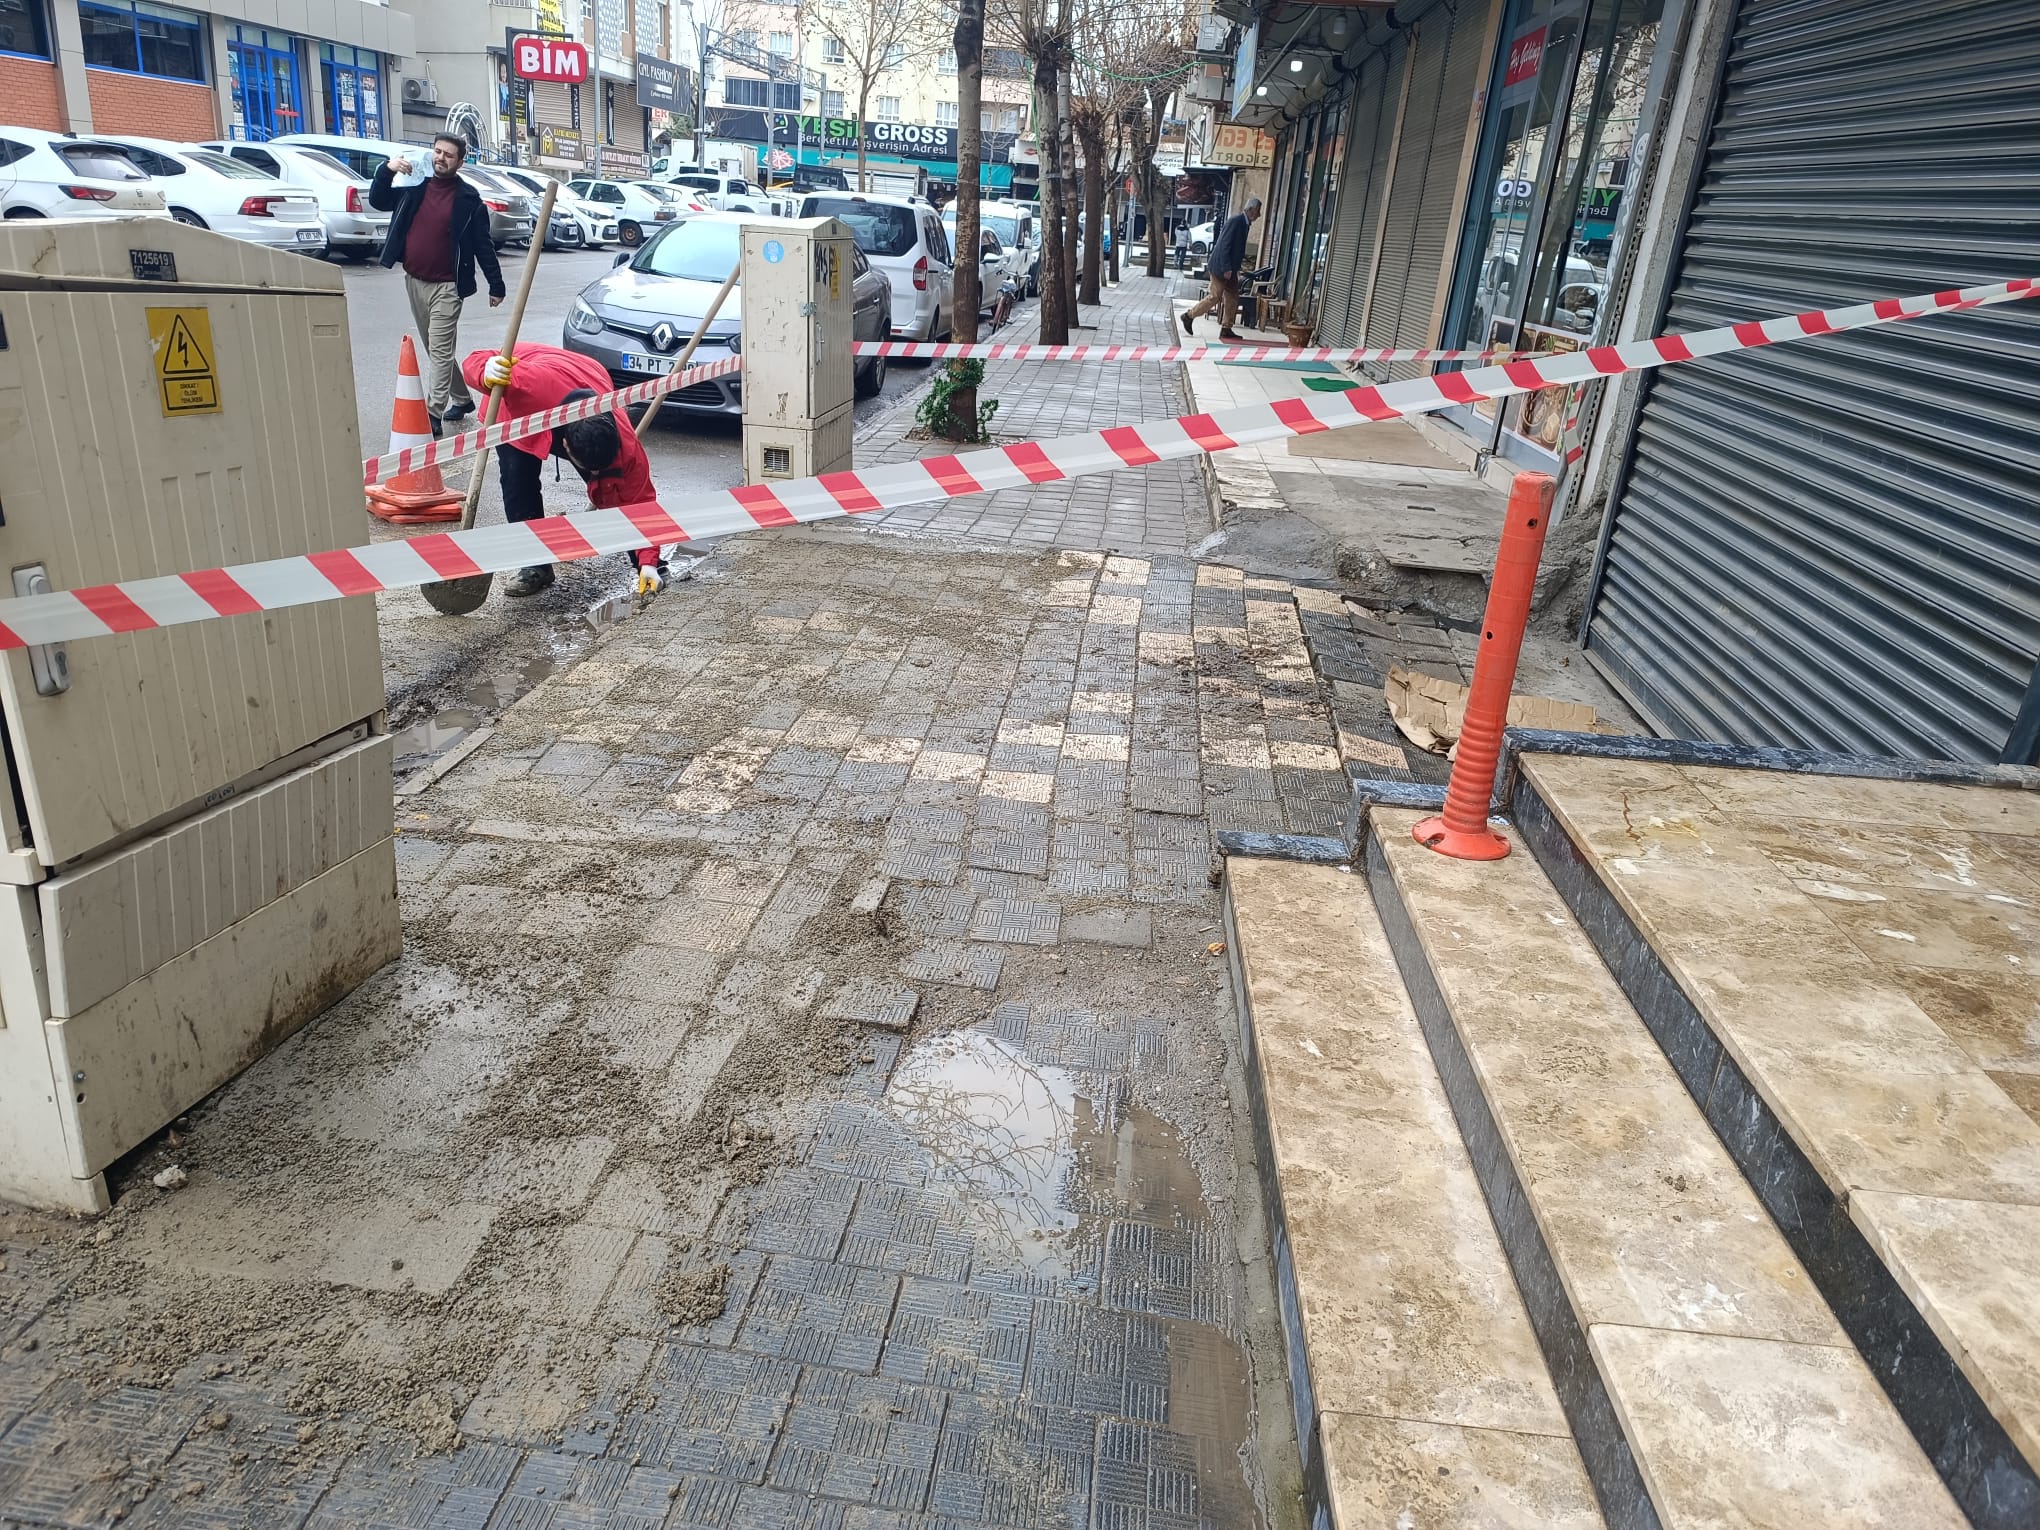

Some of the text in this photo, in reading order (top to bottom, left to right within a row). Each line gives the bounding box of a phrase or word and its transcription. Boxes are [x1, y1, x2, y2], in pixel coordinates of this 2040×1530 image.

[521, 41, 580, 76] BİM
[874, 123, 948, 145] GROSS
[852, 138, 909, 152] Aışverişin
[912, 143, 948, 155] Adresi
[132, 251, 169, 266] 7125619
[629, 356, 642, 370] 34
[647, 359, 661, 373] PT
